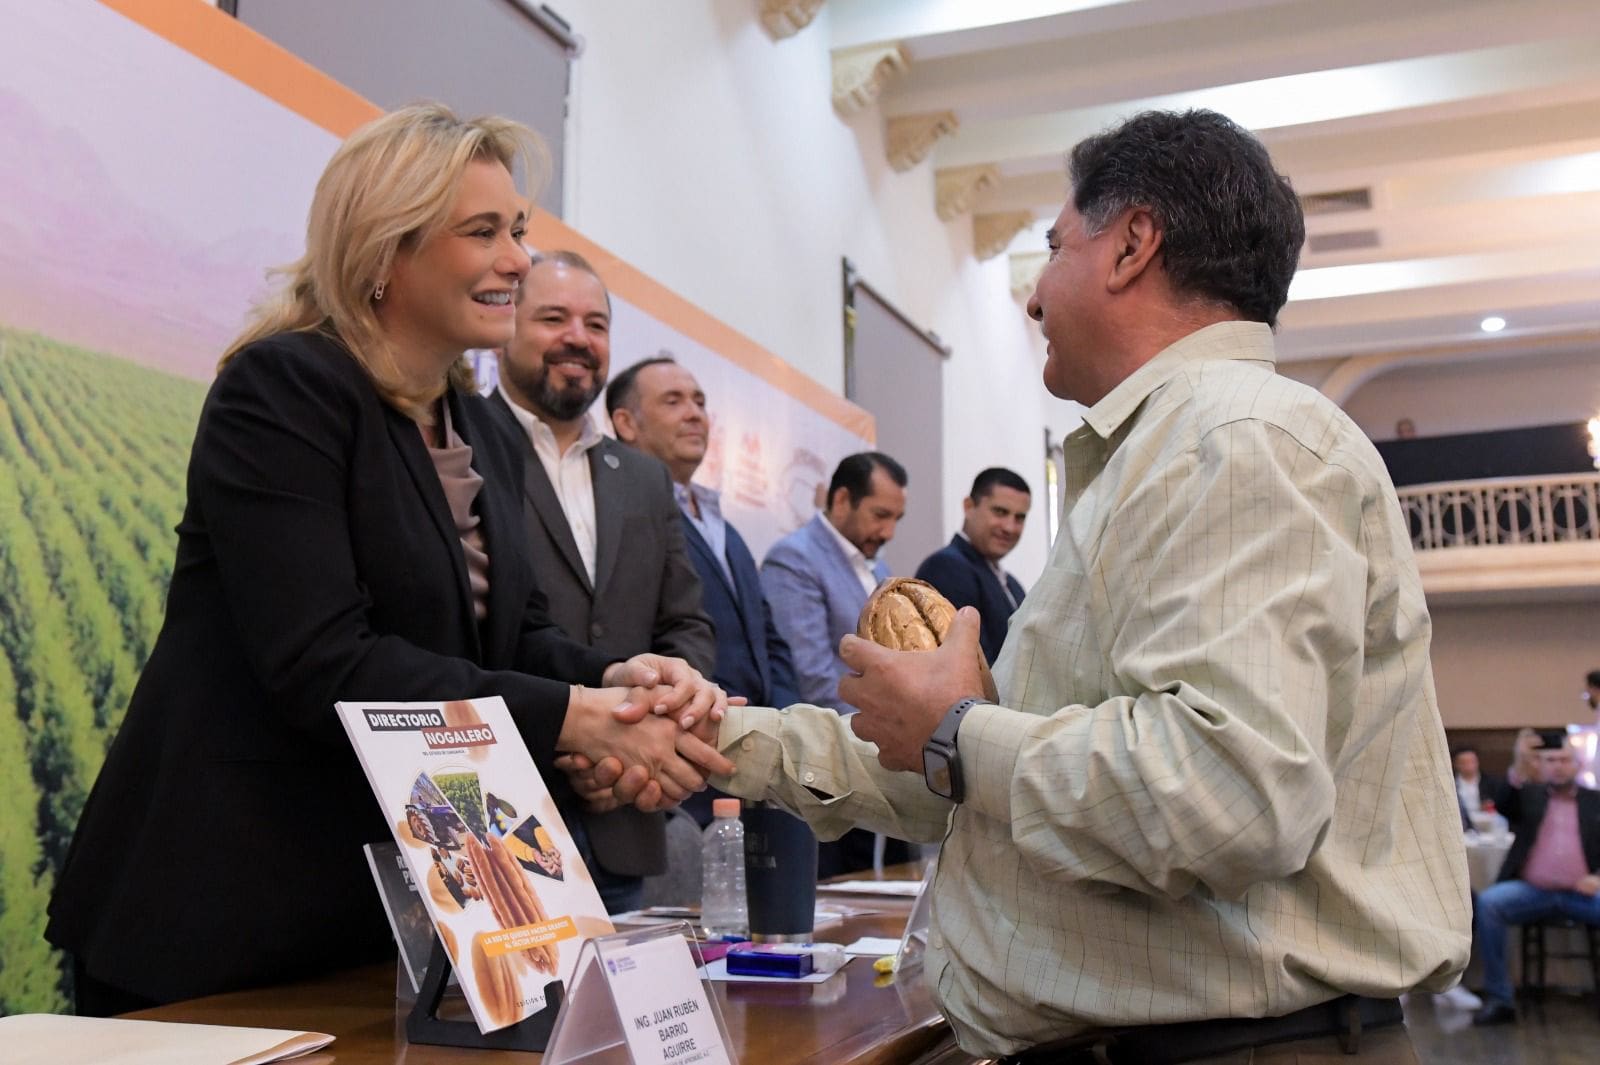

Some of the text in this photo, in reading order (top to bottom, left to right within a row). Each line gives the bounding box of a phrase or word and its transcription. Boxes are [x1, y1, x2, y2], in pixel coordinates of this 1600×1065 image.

[368, 713, 441, 727] DIRECTORIO
[425, 728, 493, 745] NOGALERO
[634, 998, 699, 1030] ING. JUAN RUBÉN
[658, 1022, 688, 1042] BARRIO
[663, 1038, 697, 1061] AGUIRRE
